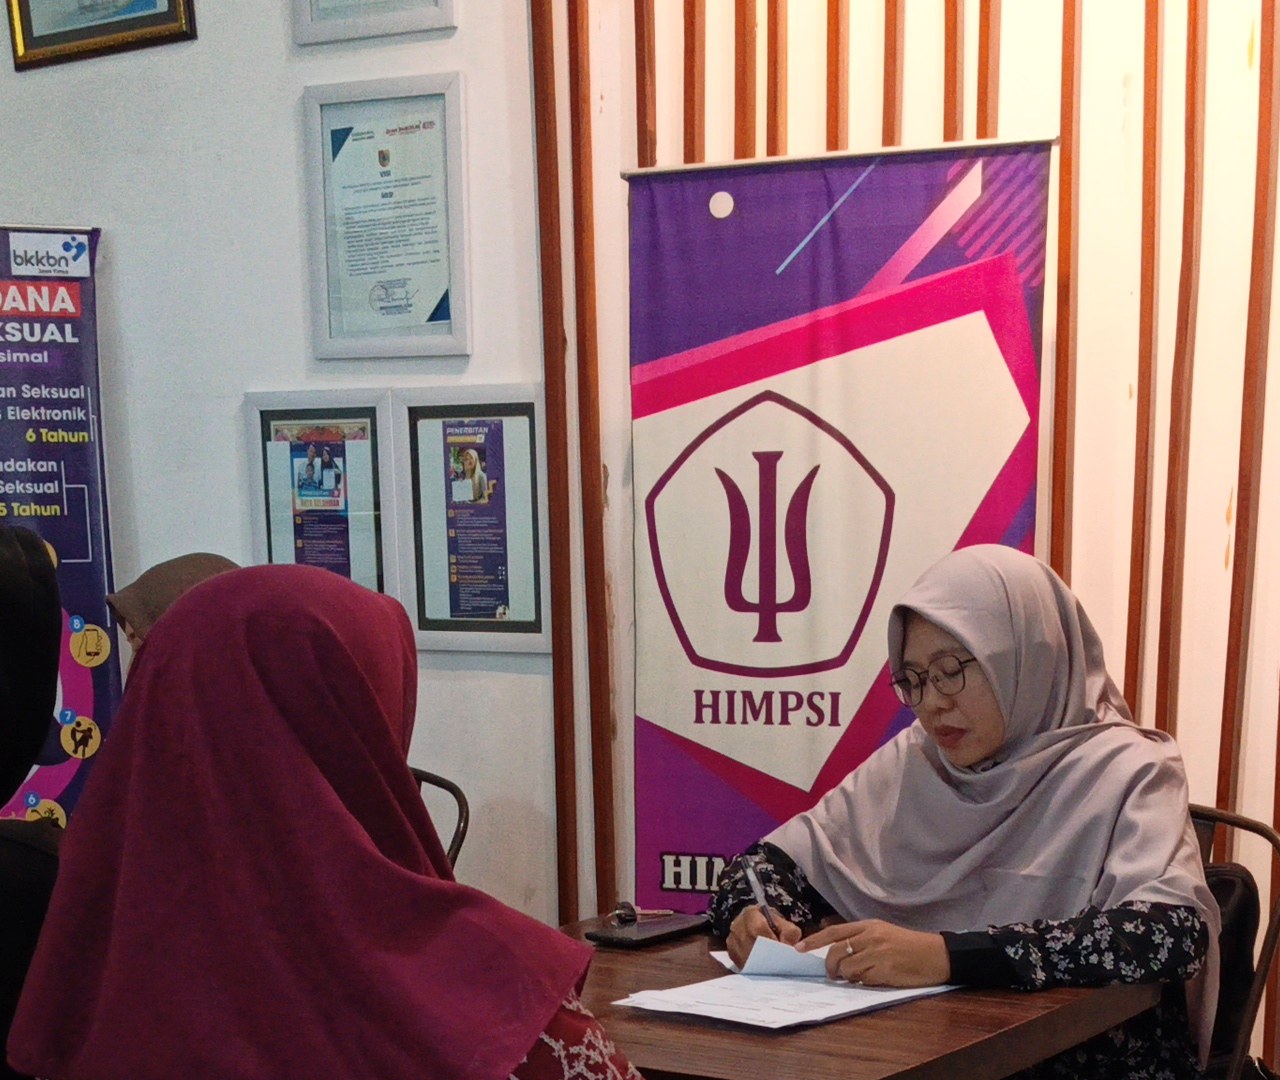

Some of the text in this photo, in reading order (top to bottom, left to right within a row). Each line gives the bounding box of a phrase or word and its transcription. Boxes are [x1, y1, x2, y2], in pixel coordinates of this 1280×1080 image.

[13, 249, 69, 267] bkkbn
[21, 385, 85, 399] Seksual
[7, 406, 86, 421] Elektronik
[25, 429, 89, 443] 6 Tahun
[12, 502, 61, 517] Tahun
[693, 689, 841, 727] HIMPSI
[64, 711, 72, 721] 7
[28, 795, 36, 806] 6
